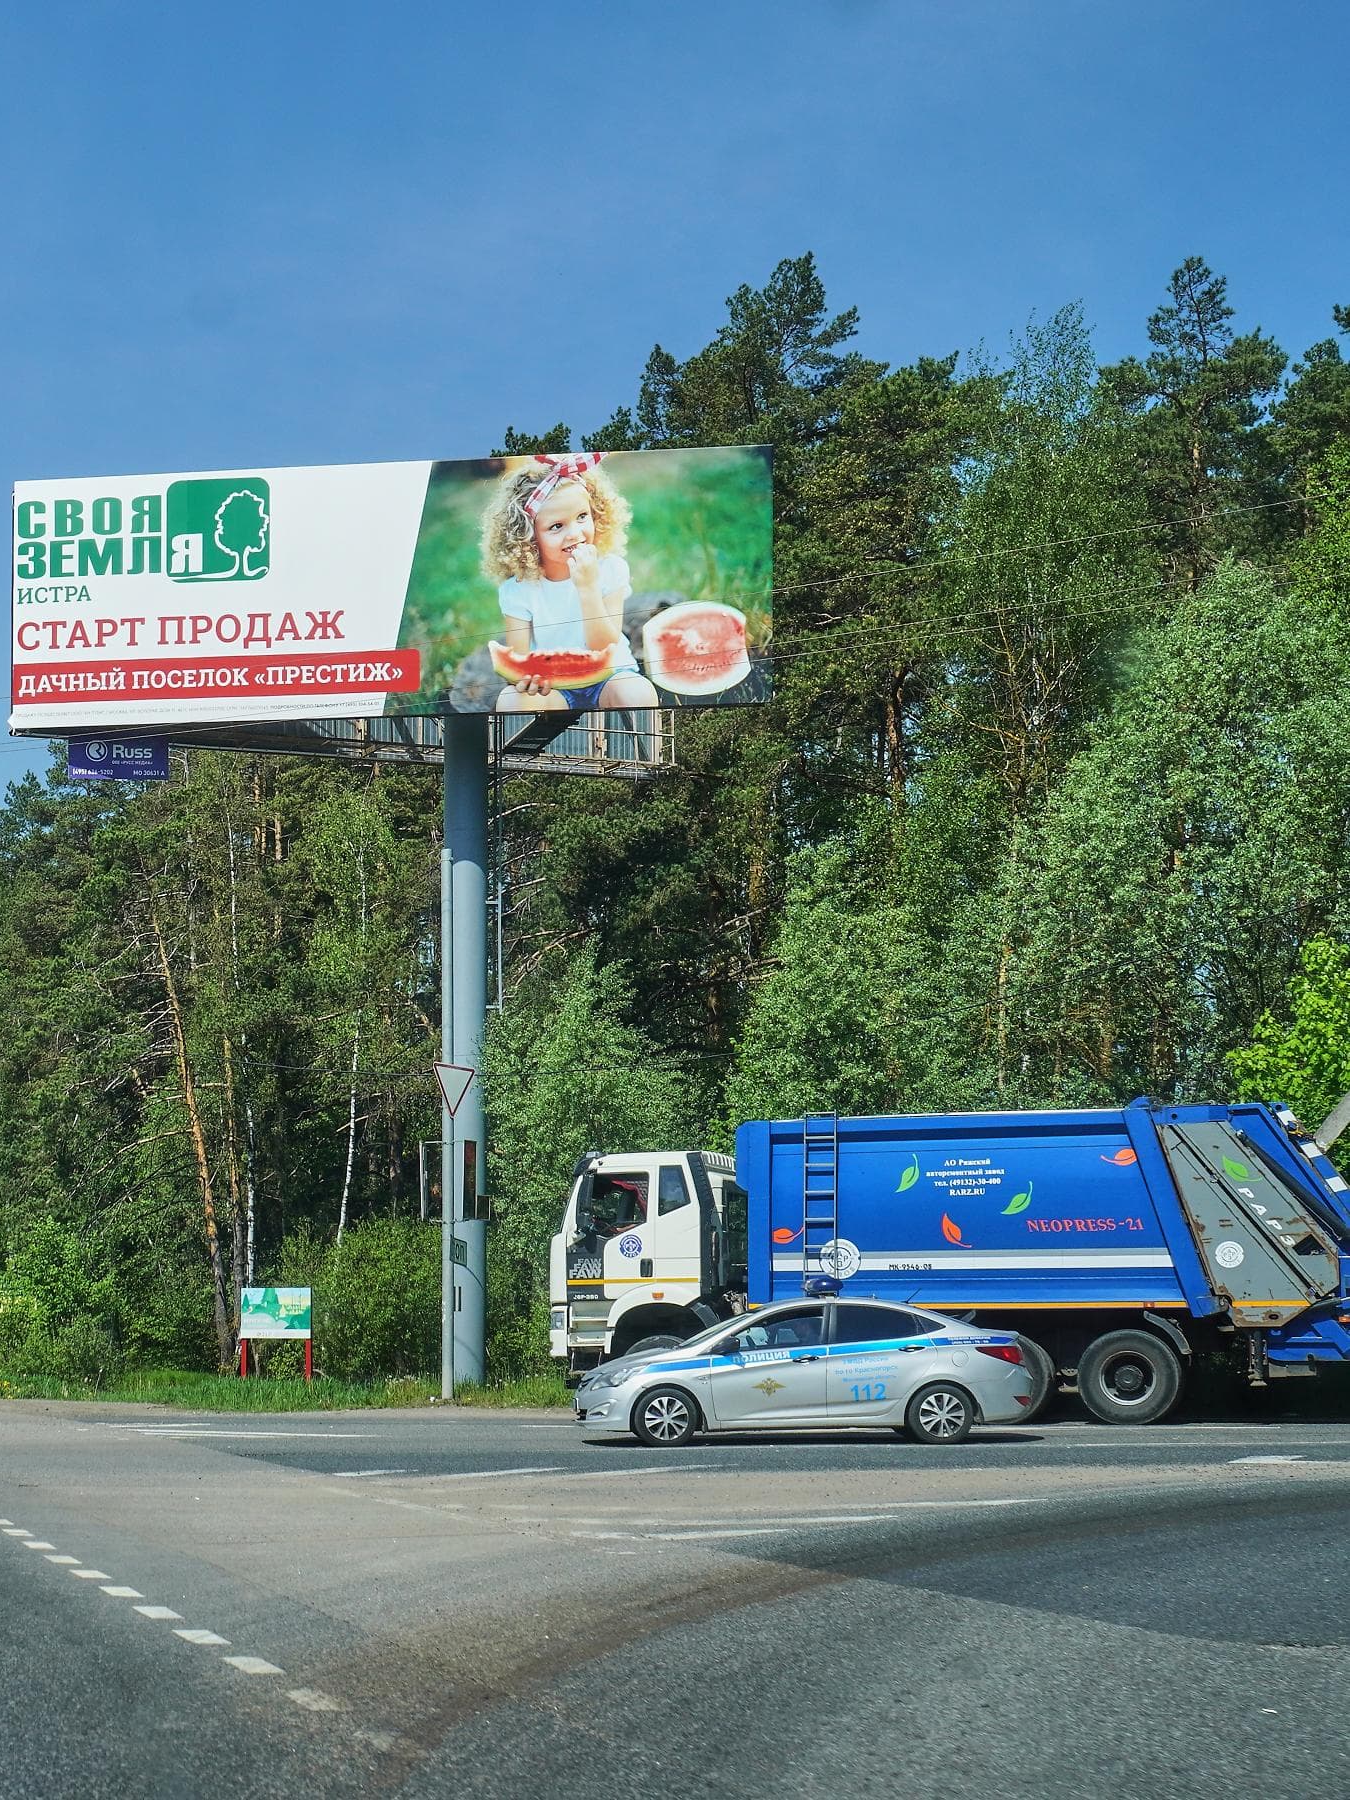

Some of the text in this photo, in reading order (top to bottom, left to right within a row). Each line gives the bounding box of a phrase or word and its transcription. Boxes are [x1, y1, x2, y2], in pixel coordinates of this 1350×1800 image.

[18, 495, 162, 539] СВОЯ
[17, 533, 203, 580] ЗЕМЛЯ
[17, 585, 92, 605] ИСТРА
[17, 610, 345, 651] СТАРТ ПРОДАЖ
[18, 662, 403, 698] ДАЧНЫЙ ПОСЕЛОК «ПРЕСТИЖ»
[569, 1269, 602, 1279] FAW
[850, 1382, 887, 1402] 112
